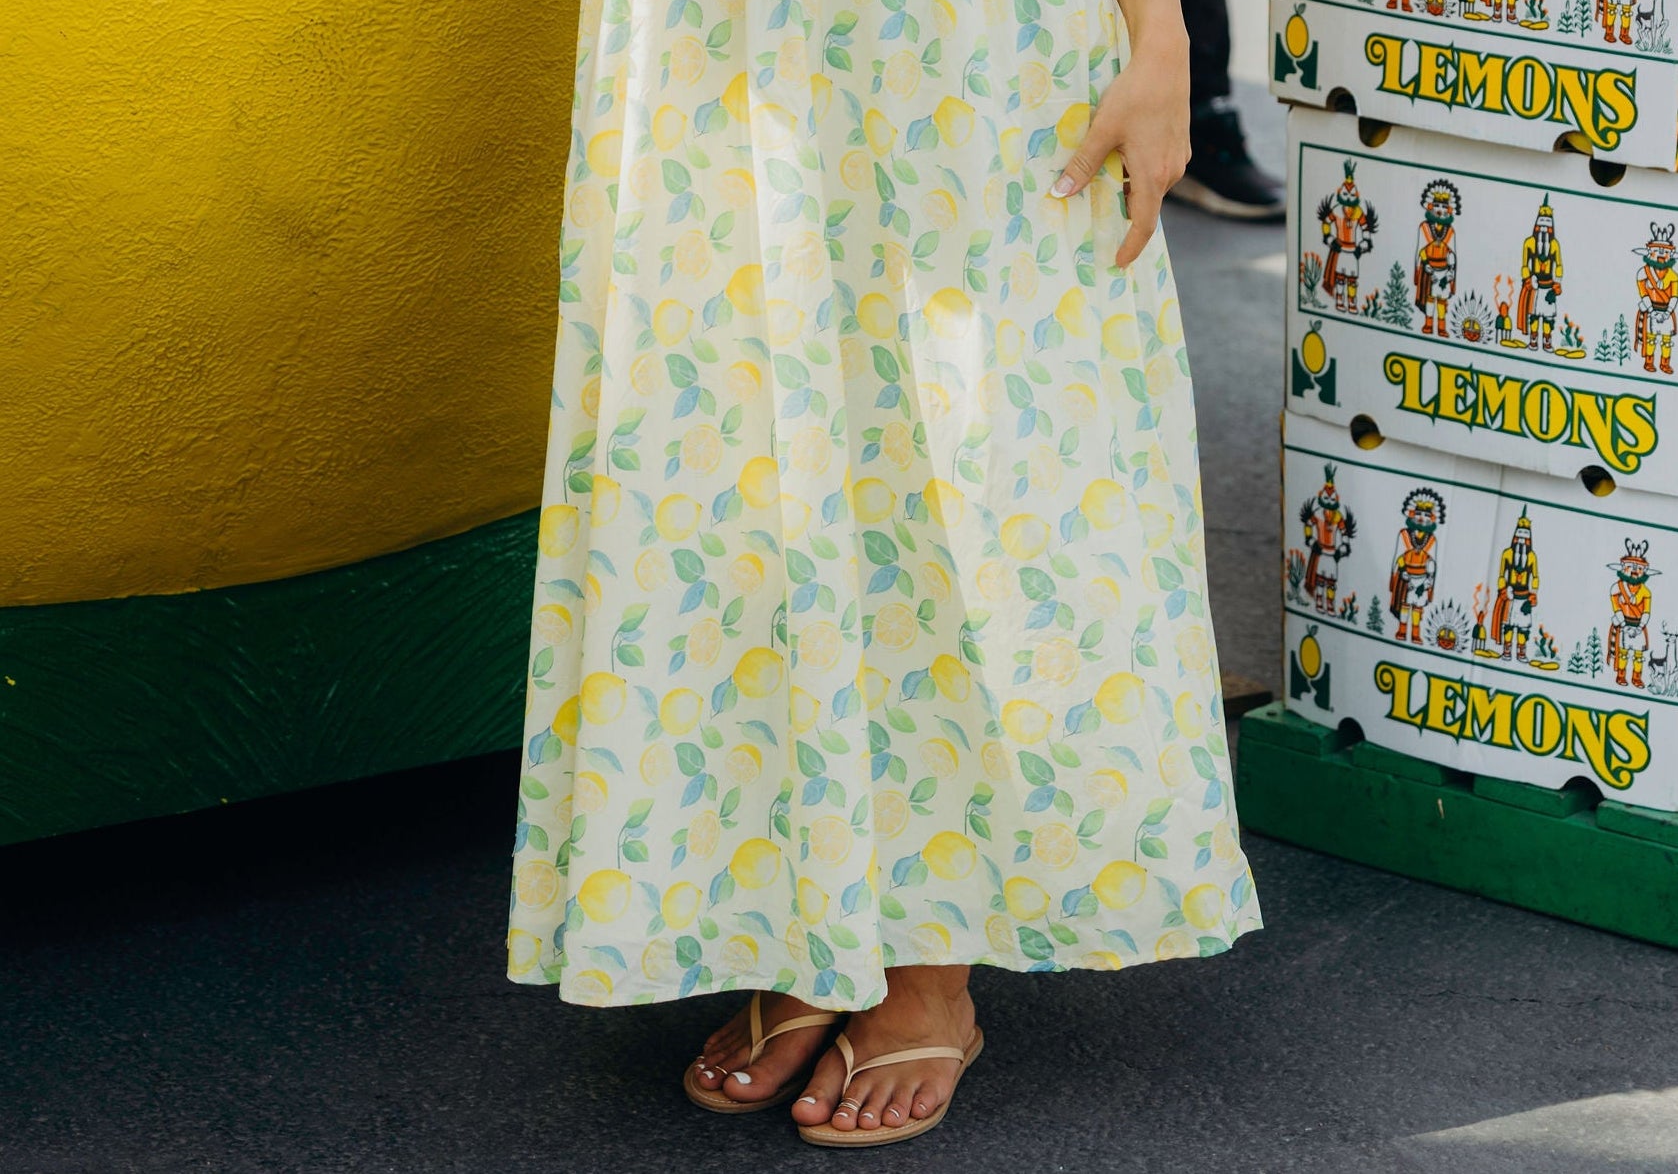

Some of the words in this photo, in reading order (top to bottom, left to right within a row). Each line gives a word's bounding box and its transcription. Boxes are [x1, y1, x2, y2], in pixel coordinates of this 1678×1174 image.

[1365, 33, 1639, 151] LEMONS
[1383, 352, 1659, 475] LEMONS
[1374, 660, 1652, 790] LEMONS
